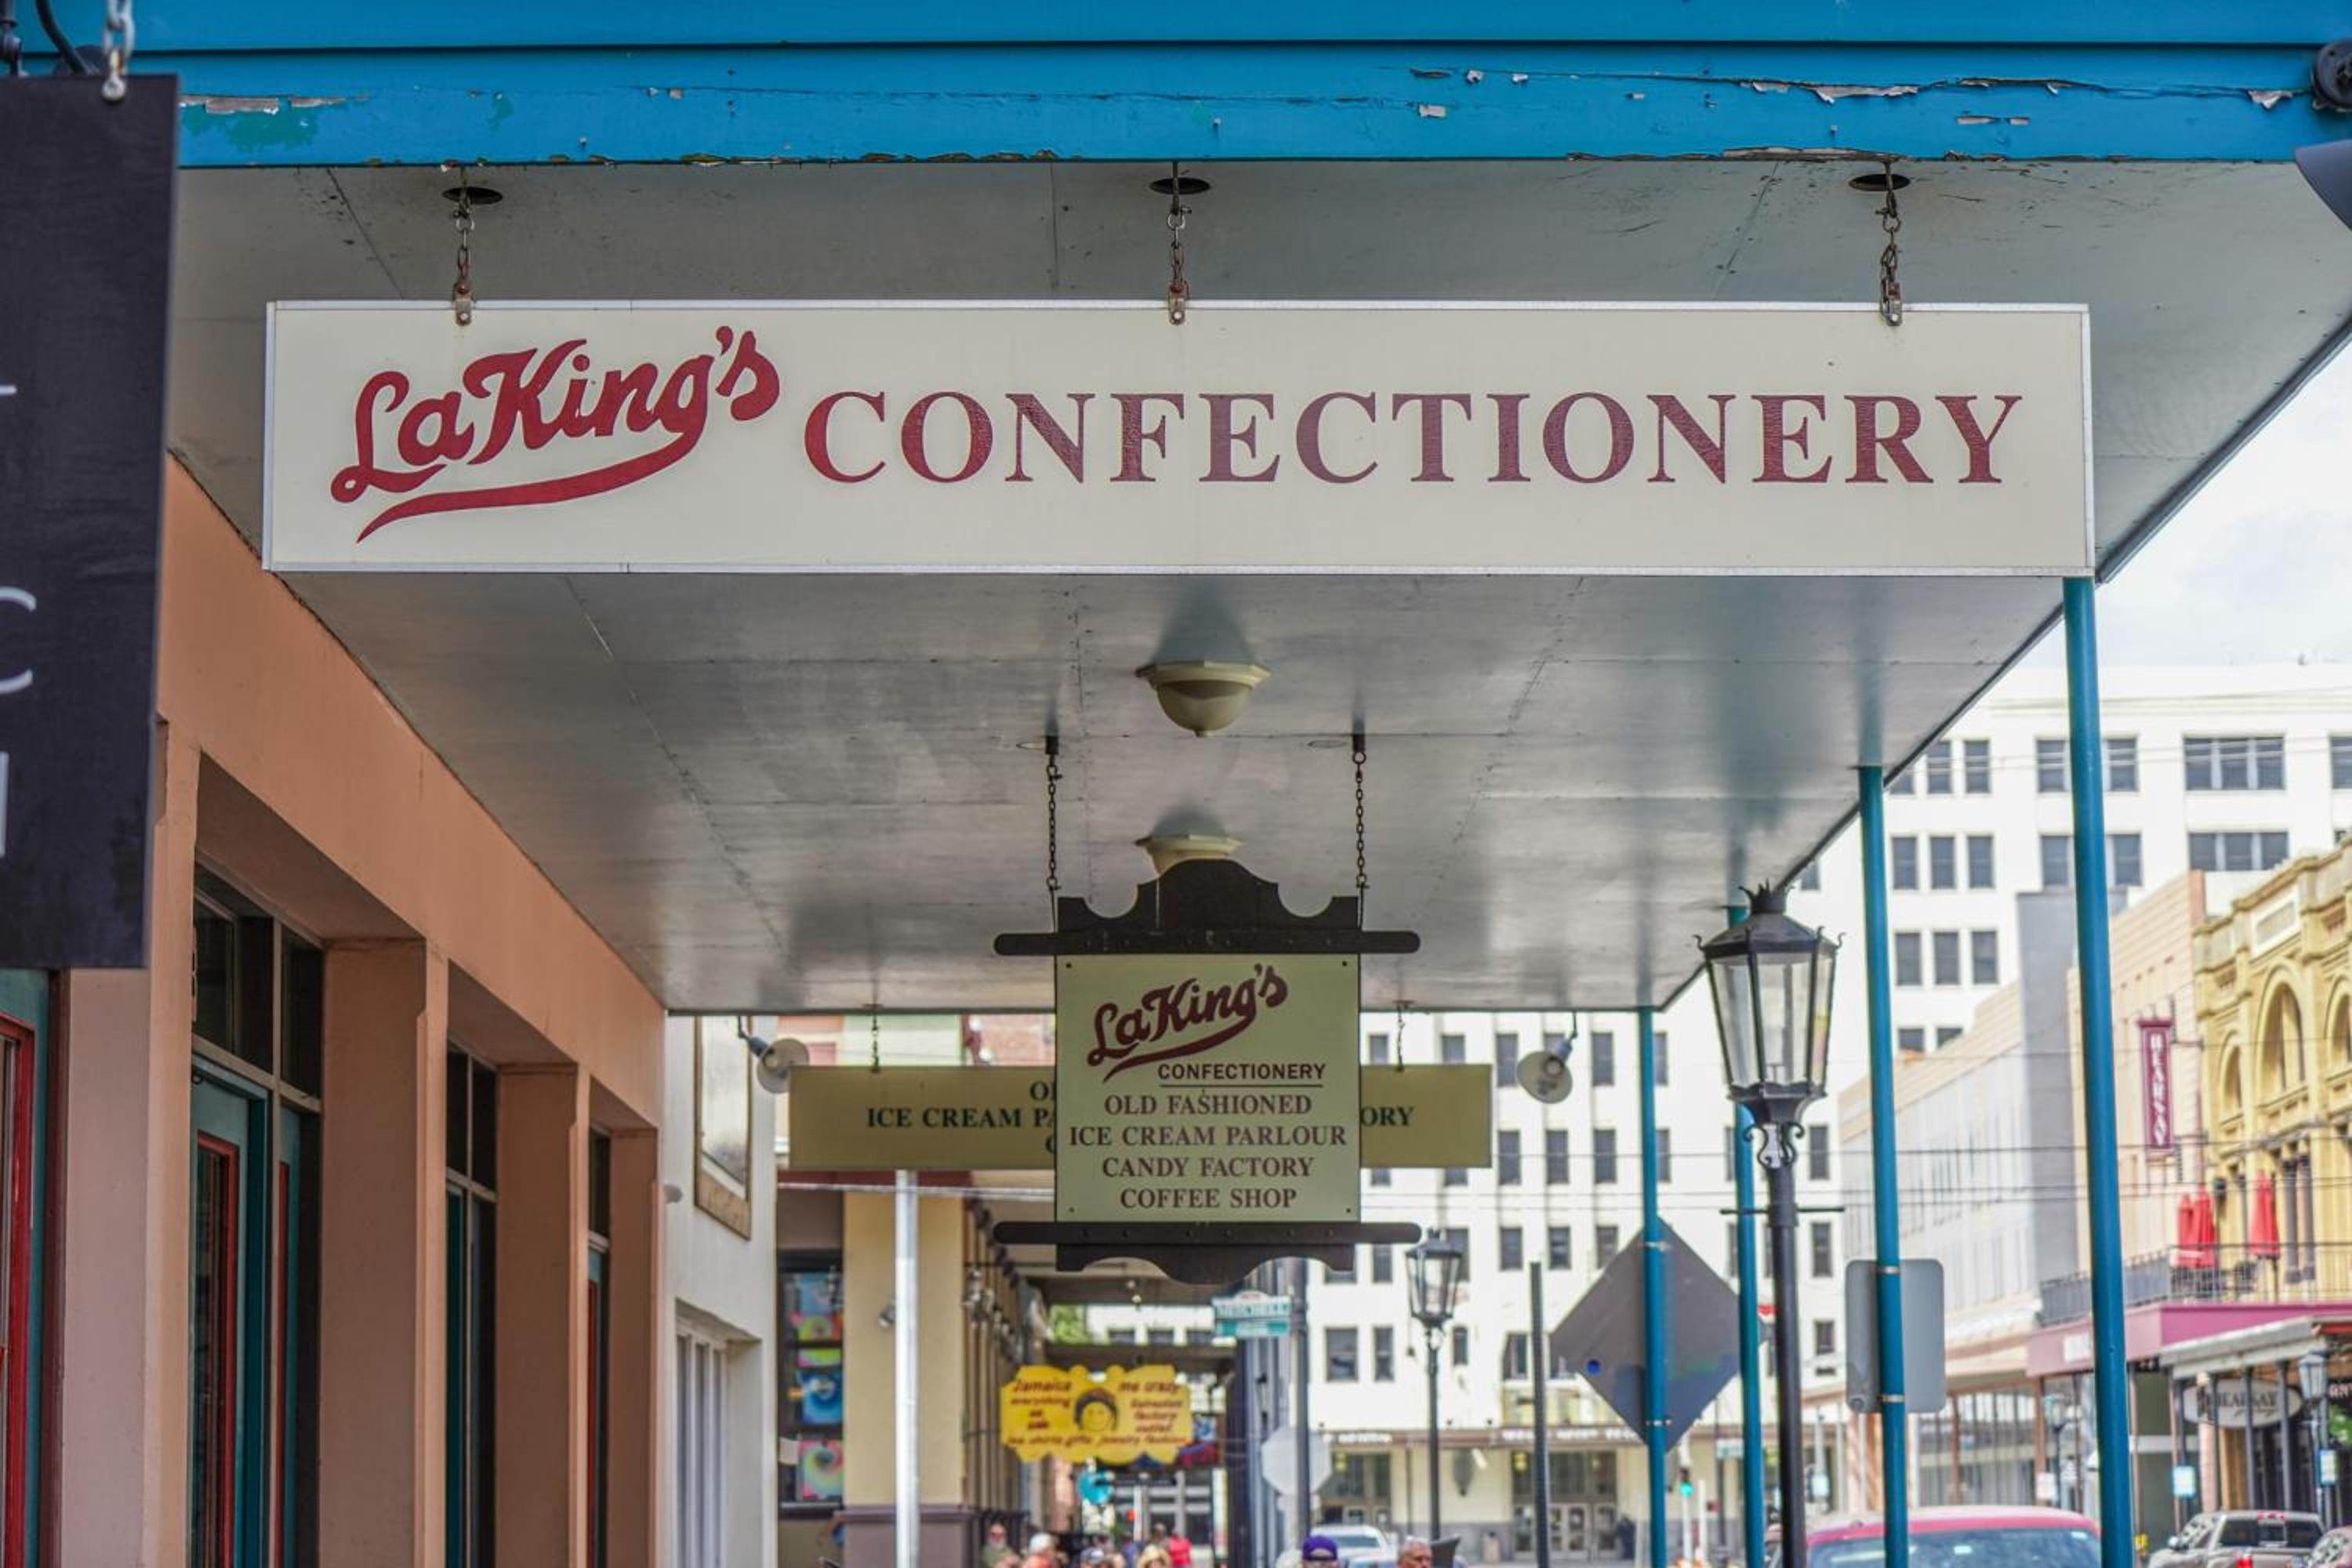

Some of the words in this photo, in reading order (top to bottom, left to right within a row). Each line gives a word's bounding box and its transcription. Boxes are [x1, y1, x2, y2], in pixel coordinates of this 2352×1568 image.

[330, 325, 780, 544] LaKing's
[804, 391, 2023, 484] CONFECTIONERY
[1087, 964, 1289, 1083] LaKing's
[1156, 1062, 1327, 1081] CONFECTIONERY
[1103, 1094, 1158, 1116] OLD
[1166, 1093, 1312, 1116] FASHIONED
[868, 1107, 912, 1128] ICE
[922, 1107, 1021, 1128] CREAM
[1067, 1125, 1113, 1147] ICE
[1120, 1125, 1216, 1147] CREAM
[1225, 1125, 1347, 1147] PARLOUR
[1101, 1156, 1190, 1178] CANDY
[1200, 1156, 1315, 1178] FACTORY
[1120, 1187, 1221, 1210] COFFEE
[1230, 1188, 1297, 1209] SHOP
